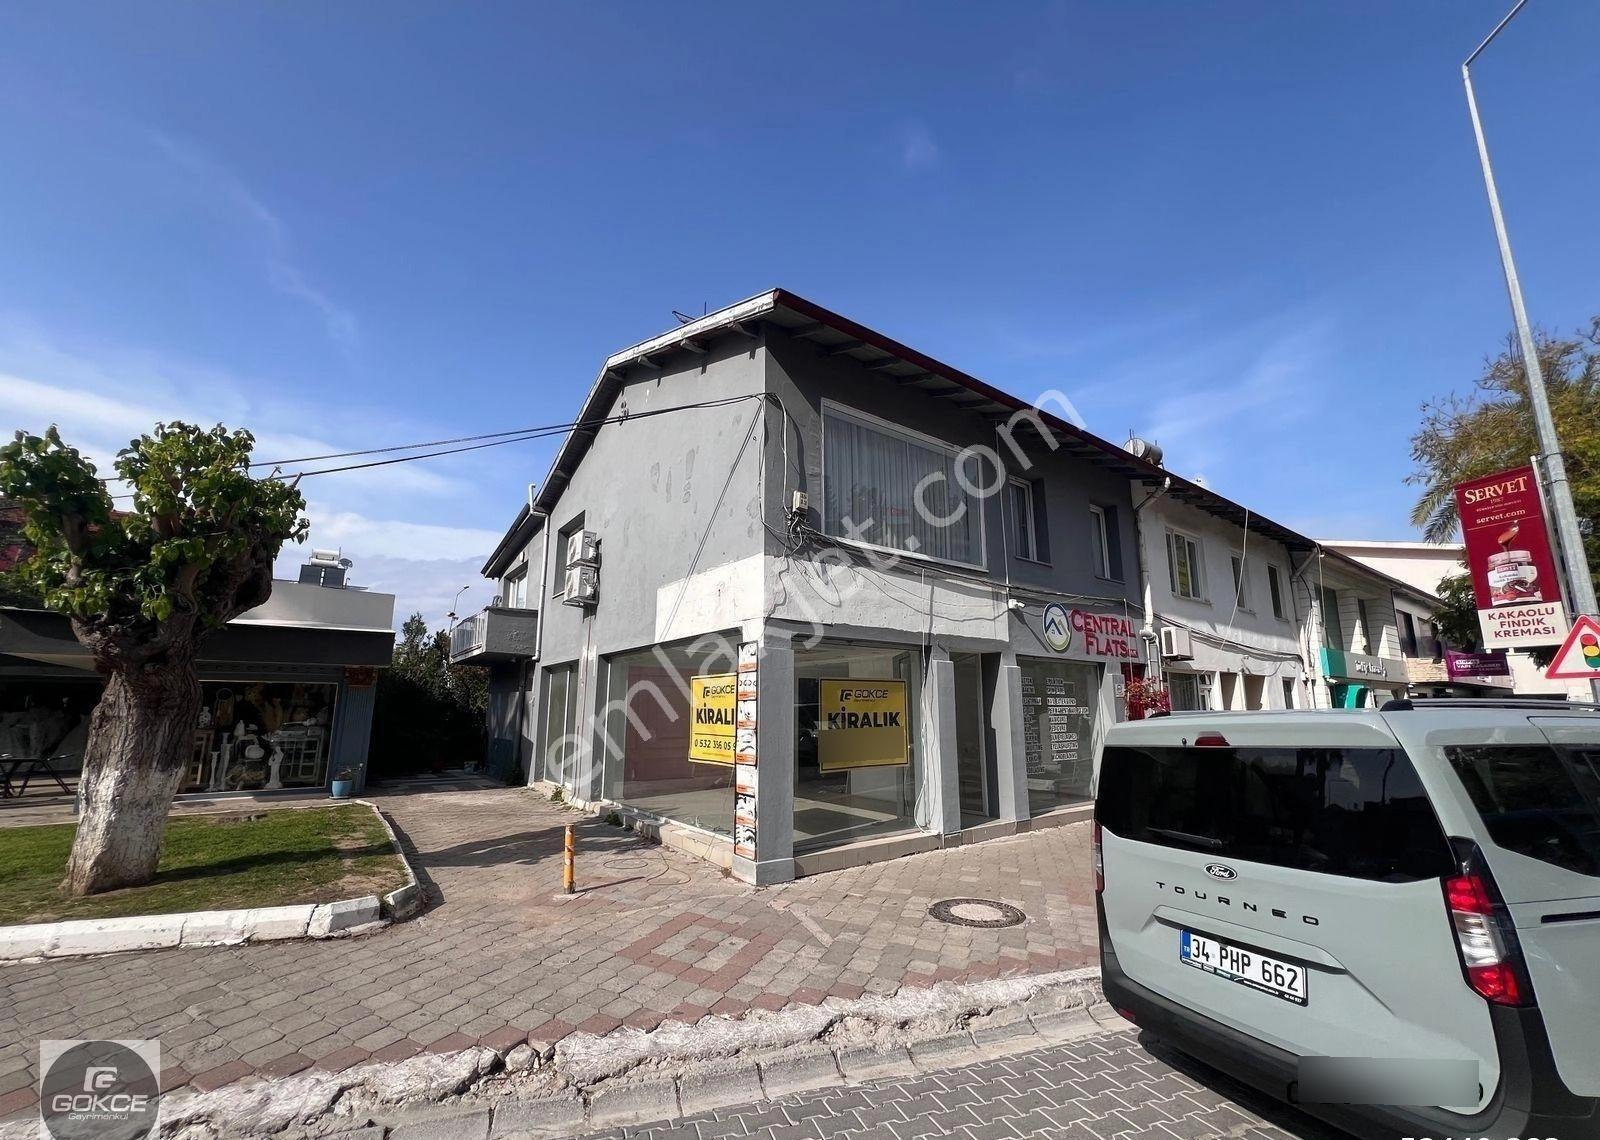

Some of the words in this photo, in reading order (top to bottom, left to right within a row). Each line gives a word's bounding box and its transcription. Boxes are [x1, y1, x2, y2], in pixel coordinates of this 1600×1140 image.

[1464, 476, 1528, 505] SERVET
[1476, 509, 1526, 524] servet.com
[1070, 608, 1136, 638] CENTRAL
[1488, 607, 1555, 620] KAKAOLU
[1500, 617, 1546, 628] FINDIK
[1494, 626, 1556, 638] KREMASI
[1085, 632, 1128, 658] FLATS
[696, 702, 735, 725] KİRALI
[827, 706, 901, 729] KİRALIK
[699, 739, 711, 748] 532
[1209, 865, 1231, 879] Ford
[1156, 881, 1319, 926] TOURNEO
[1192, 938, 1209, 962] 34
[1219, 946, 1251, 975] PHP
[1261, 959, 1298, 992] 662
